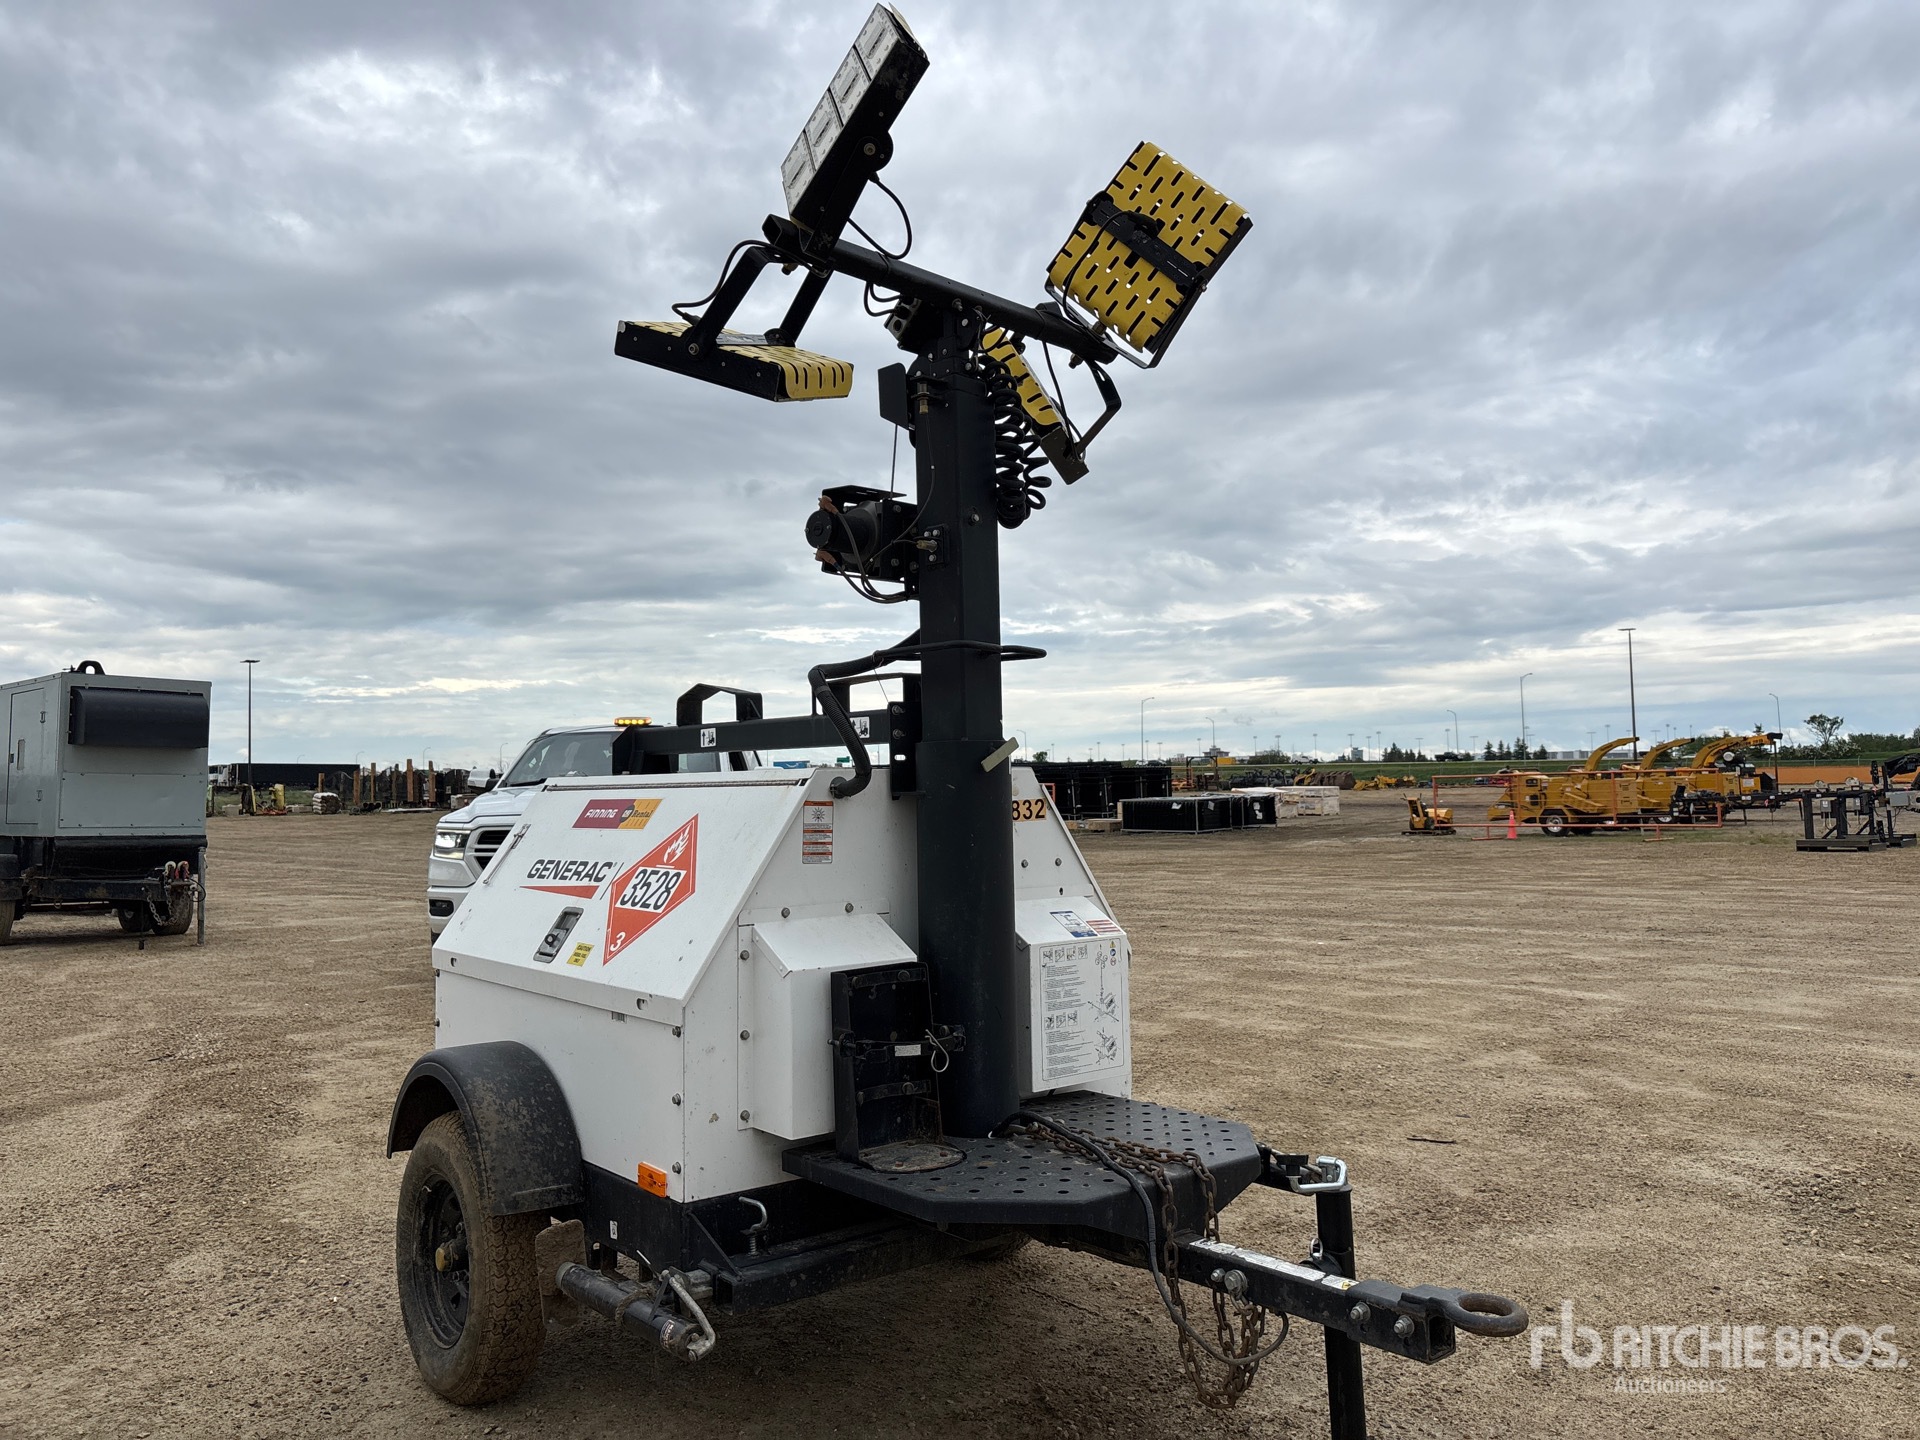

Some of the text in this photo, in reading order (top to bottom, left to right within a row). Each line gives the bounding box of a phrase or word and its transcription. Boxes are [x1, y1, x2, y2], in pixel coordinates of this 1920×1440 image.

[584, 808, 619, 818] FINNING
[1012, 798, 1046, 820] 832
[527, 859, 613, 882] GENERAC
[620, 868, 682, 911] 3528
[610, 931, 626, 952] 3
